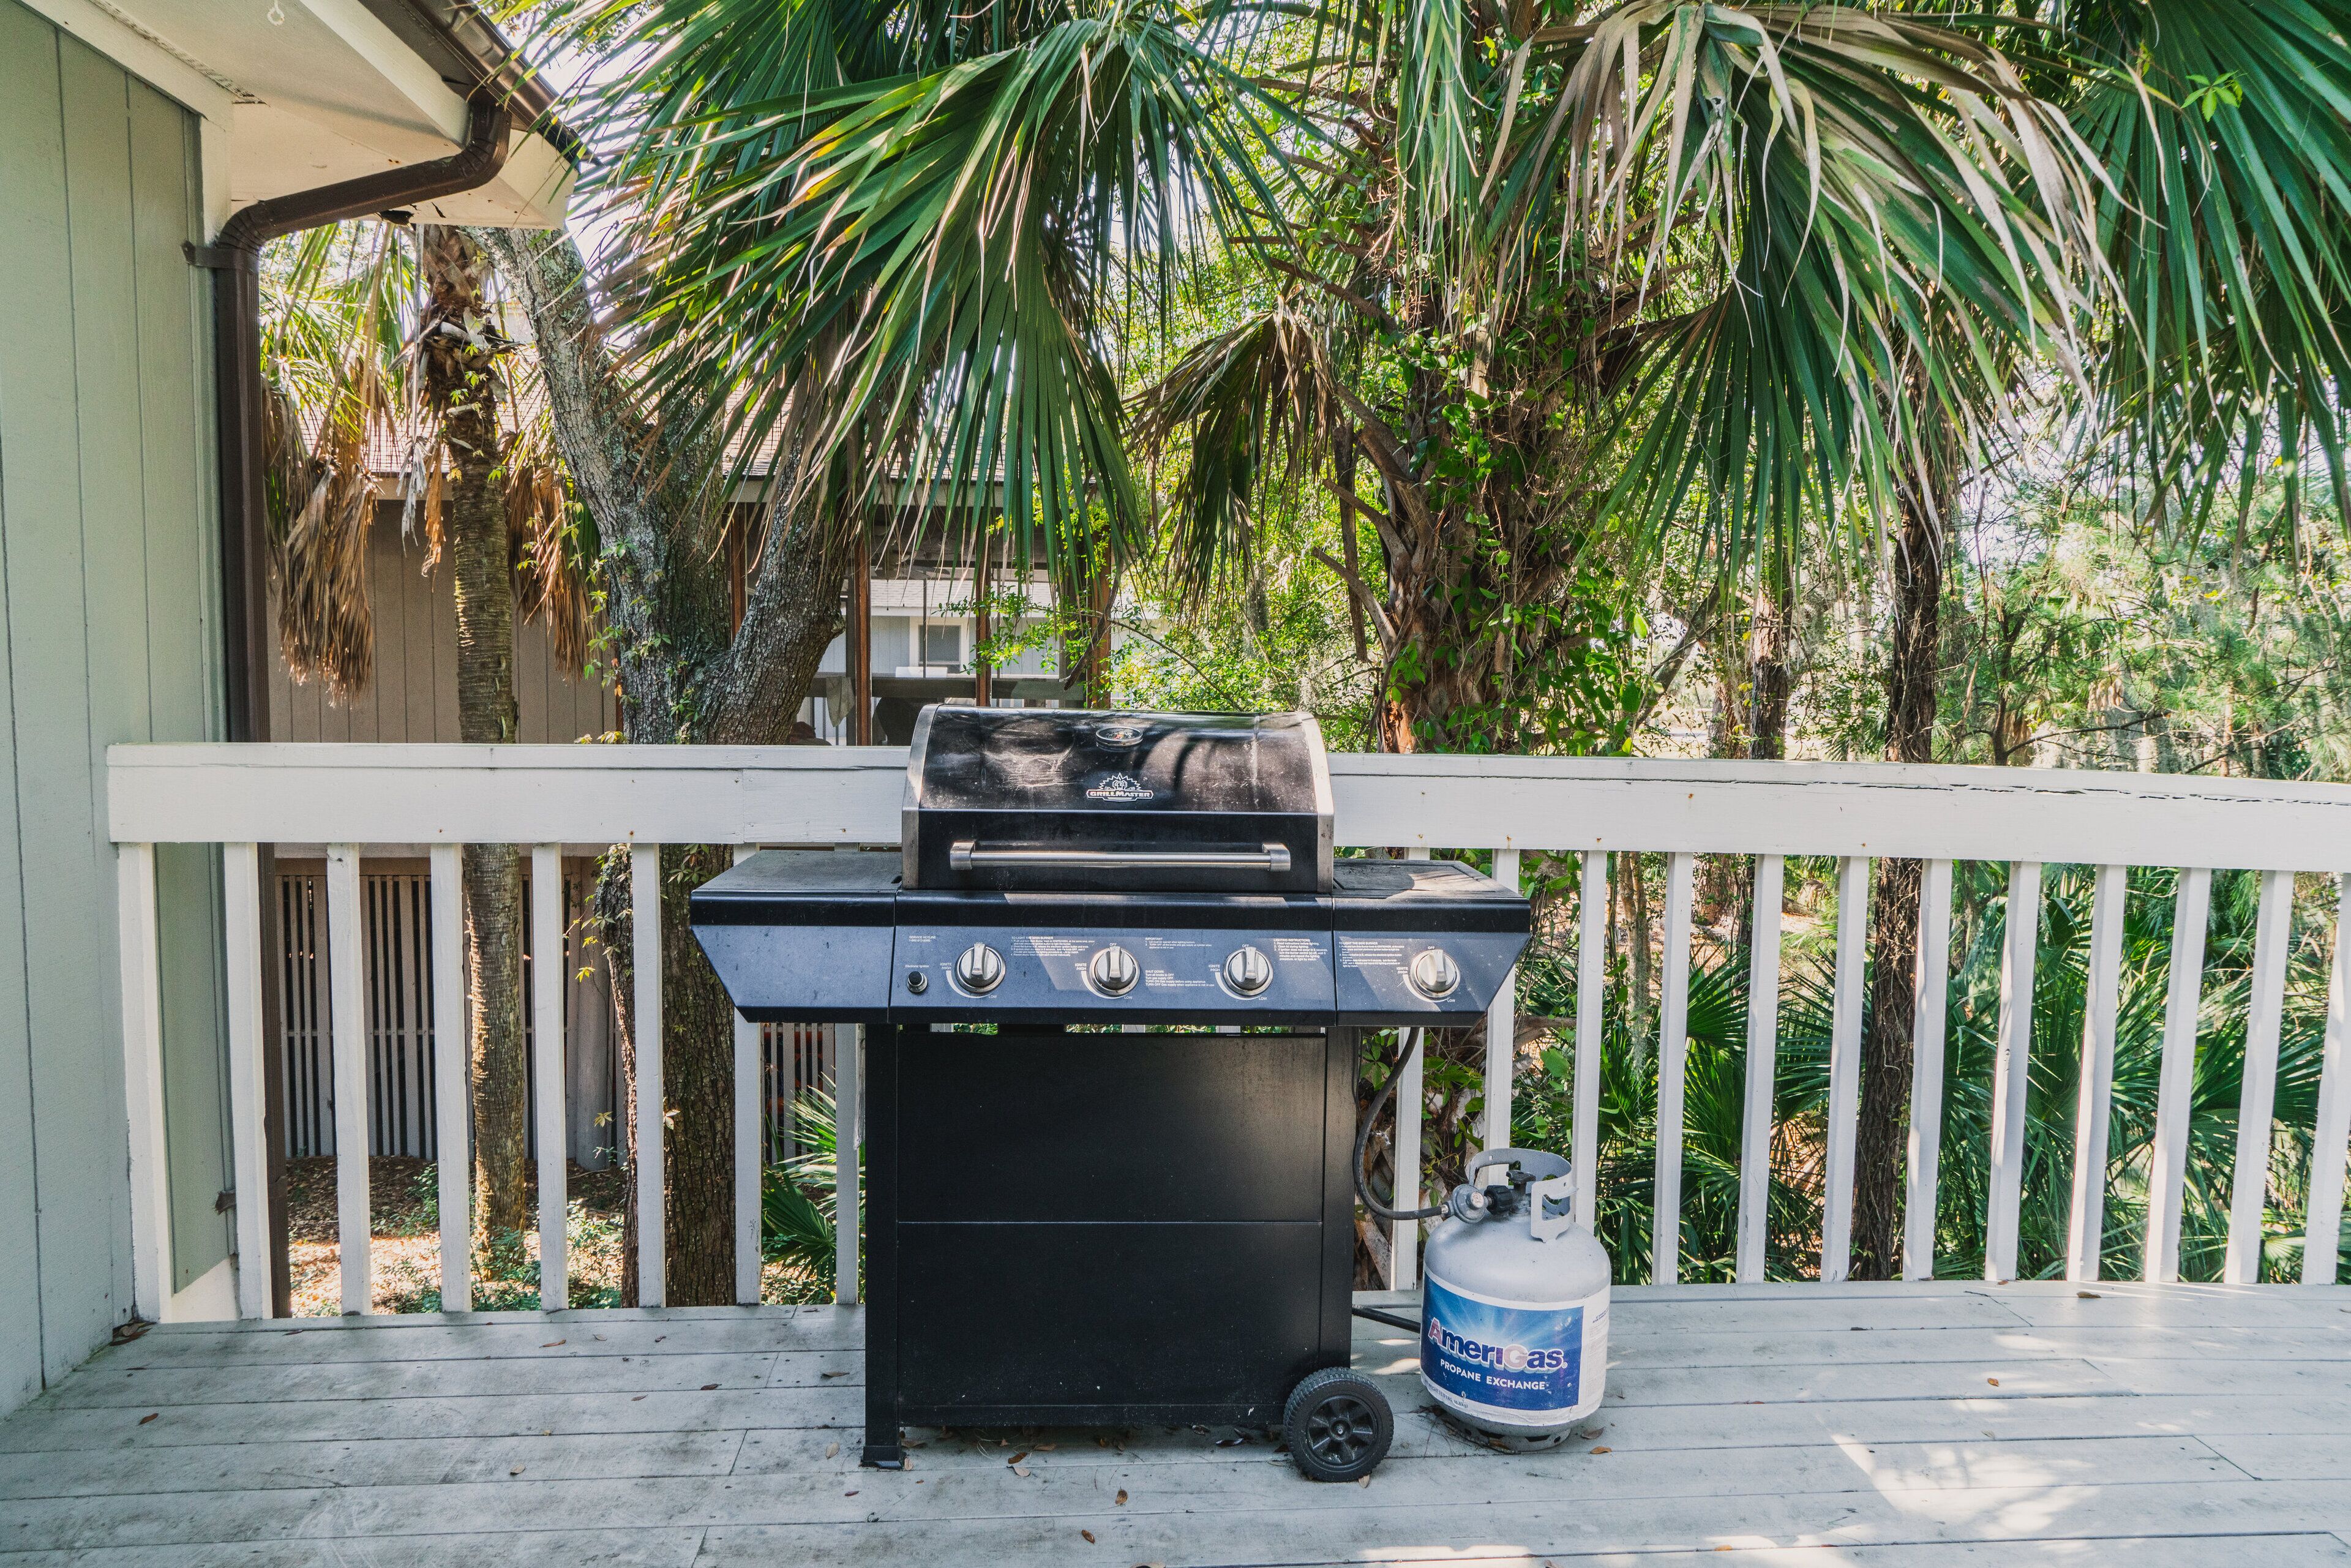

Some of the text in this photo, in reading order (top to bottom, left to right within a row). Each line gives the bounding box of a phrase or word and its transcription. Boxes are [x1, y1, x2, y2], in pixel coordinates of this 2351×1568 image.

[1428, 1317, 1565, 1371] AmeriGas
[1440, 1359, 1546, 1390] PROPANE EXCHANGE
